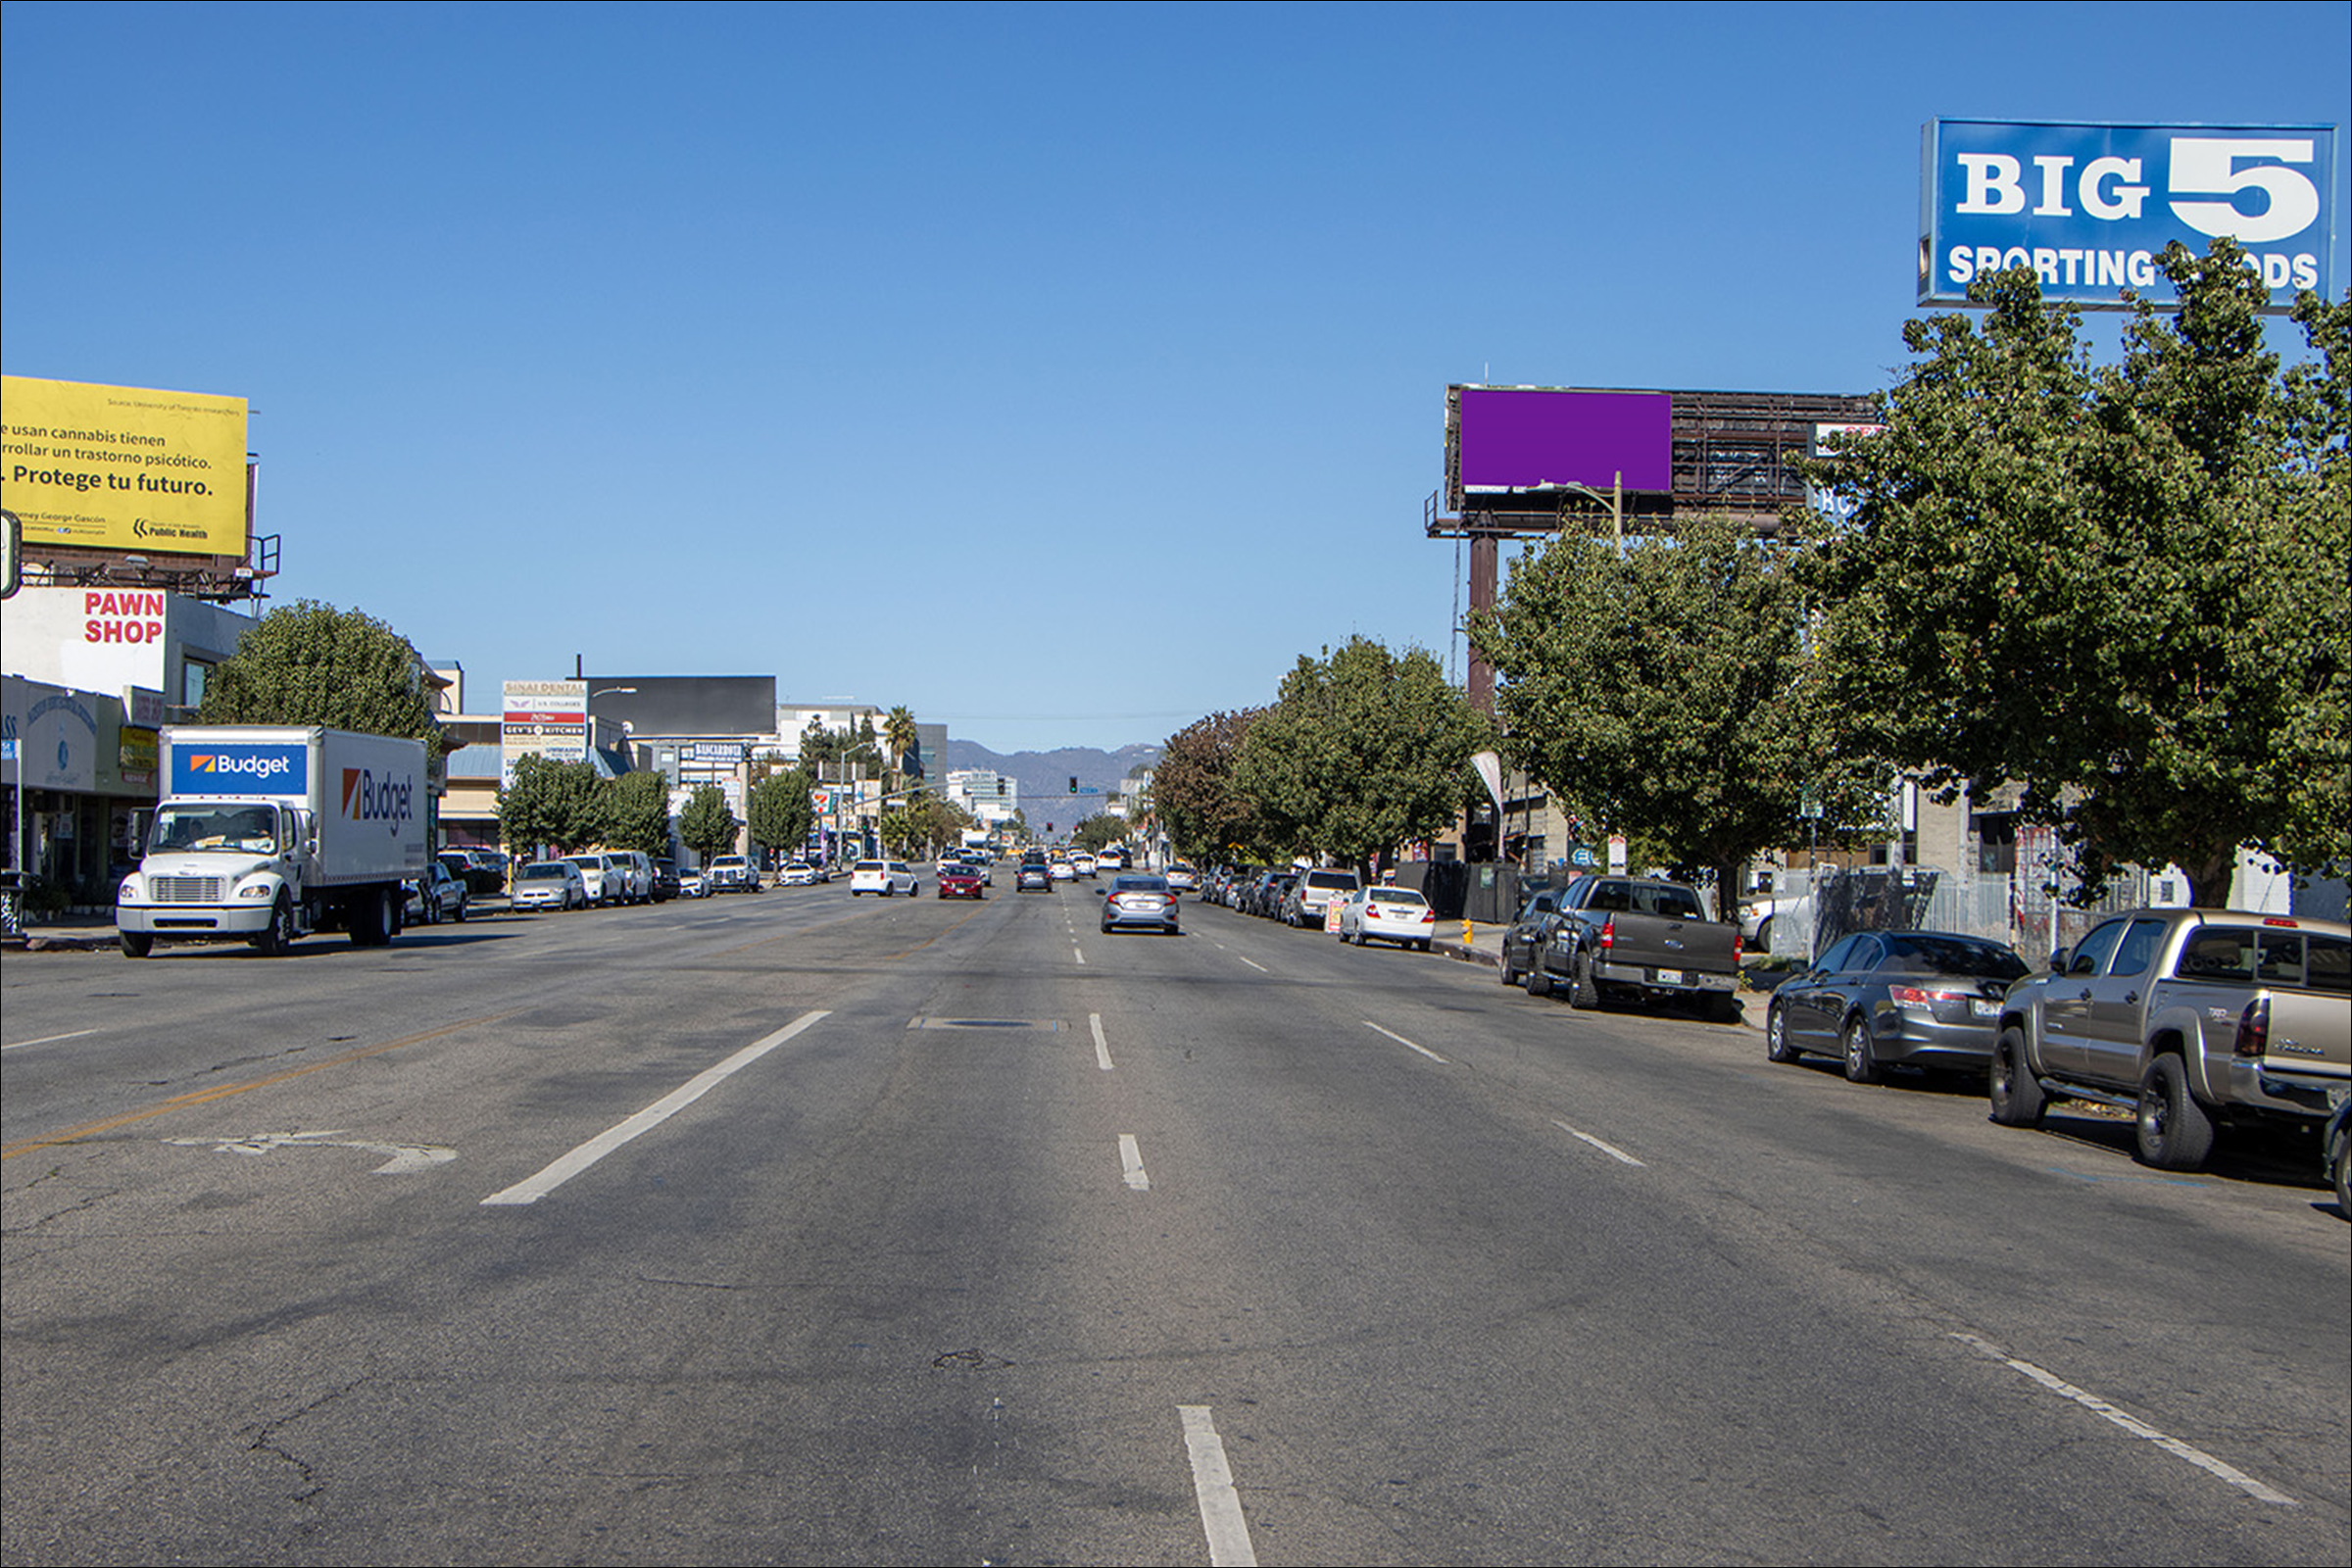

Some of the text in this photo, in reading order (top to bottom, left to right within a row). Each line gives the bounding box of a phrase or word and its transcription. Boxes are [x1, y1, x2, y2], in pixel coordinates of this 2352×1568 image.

[1956, 137, 2320, 243] BIG 5
[12, 425, 48, 437] usan
[51, 427, 118, 444] cannabis
[121, 432, 166, 447] tienen
[52, 447, 72, 459] un
[75, 448, 142, 465] trastorno
[145, 454, 212, 470] psicótico.
[14, 465, 214, 497] Protege tu futuro.
[41, 513, 73, 522] George
[149, 527, 209, 539] Public Health
[84, 592, 165, 617] PAWN
[84, 620, 163, 644] SHOP
[541, 682, 585, 694] DENTAL
[545, 726, 584, 735] KITCHEN
[218, 755, 290, 779] Budget
[363, 767, 413, 835] Budget
